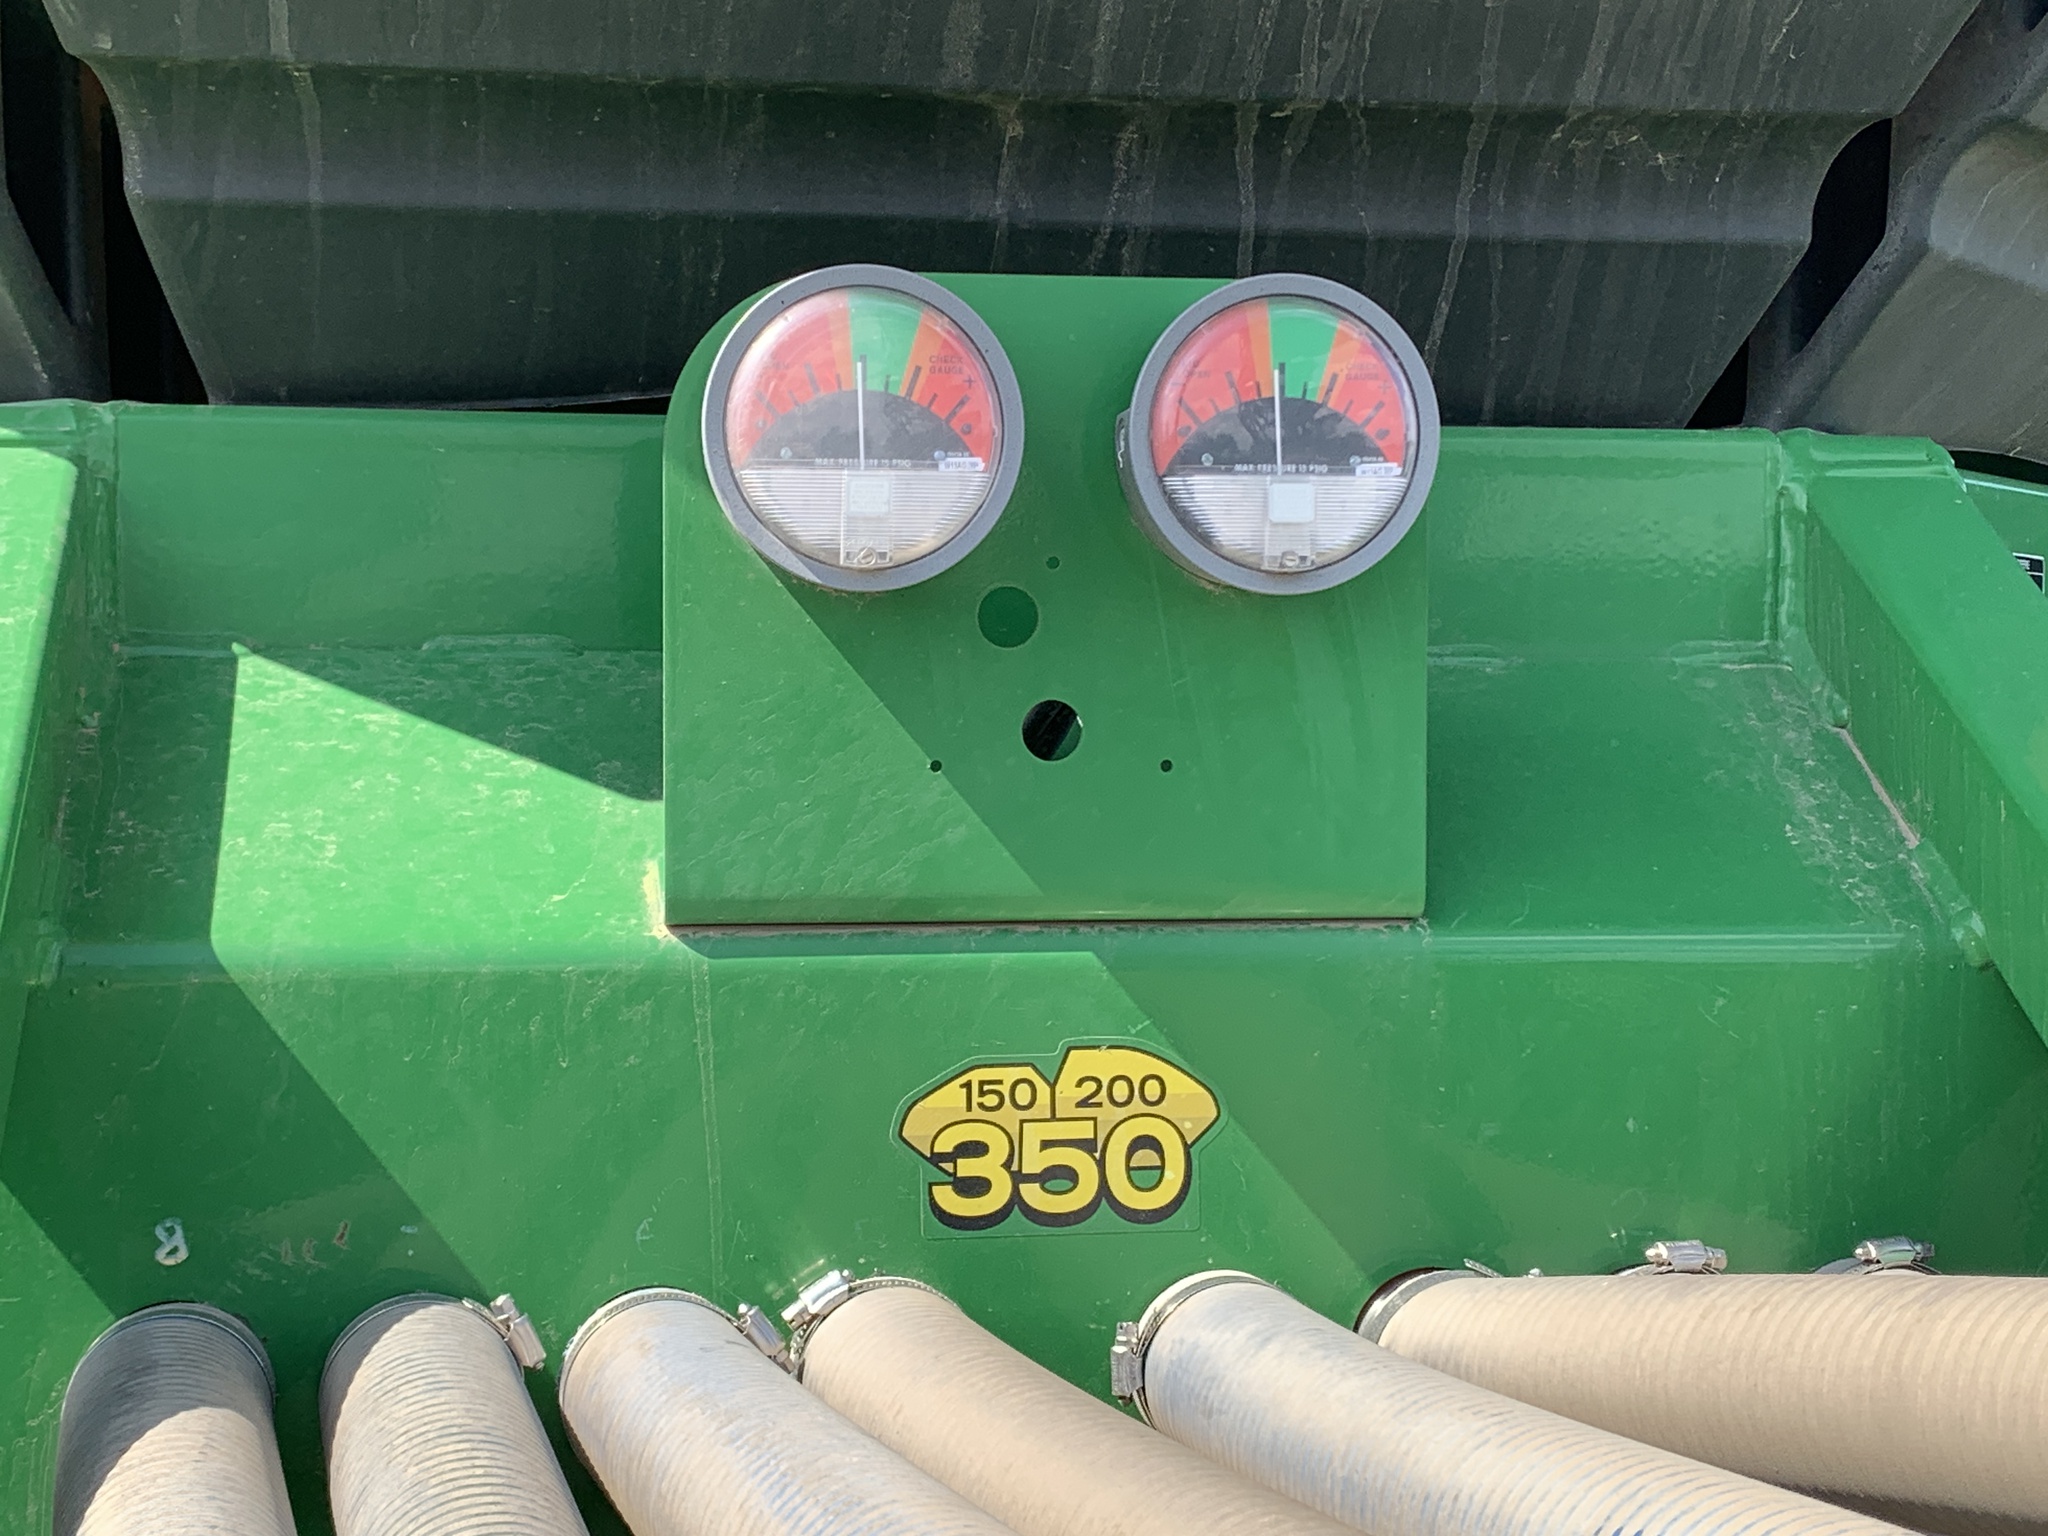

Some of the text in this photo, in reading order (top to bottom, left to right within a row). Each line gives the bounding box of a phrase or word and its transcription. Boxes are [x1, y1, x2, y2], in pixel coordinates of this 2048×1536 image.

[838, 457, 879, 467] PRESURE
[1257, 463, 1297, 473] PRESURE
[958, 1077, 1038, 1113] 150
[1074, 1073, 1167, 1109] 200
[929, 1113, 1191, 1229] 350
